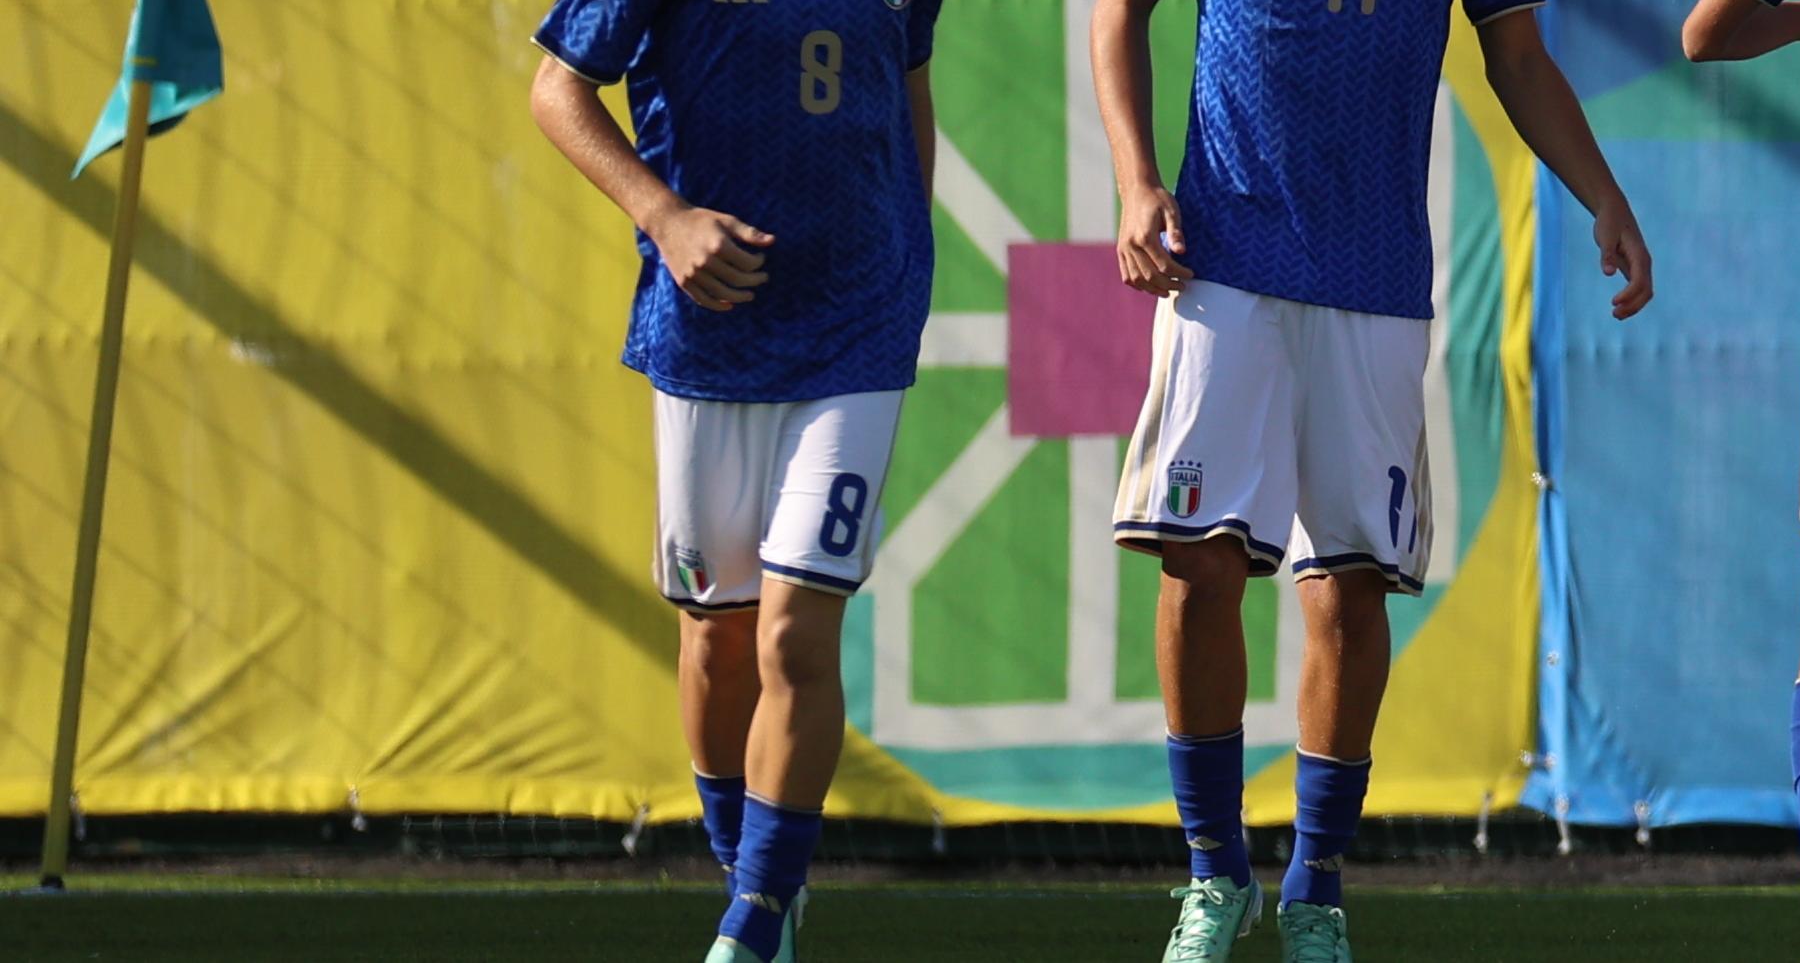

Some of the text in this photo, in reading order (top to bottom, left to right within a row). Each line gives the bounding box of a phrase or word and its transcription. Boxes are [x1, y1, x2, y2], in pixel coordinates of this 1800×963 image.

[799, 30, 843, 115] 8
[818, 472, 868, 558] 8
[1170, 471, 1200, 483] ITALIA
